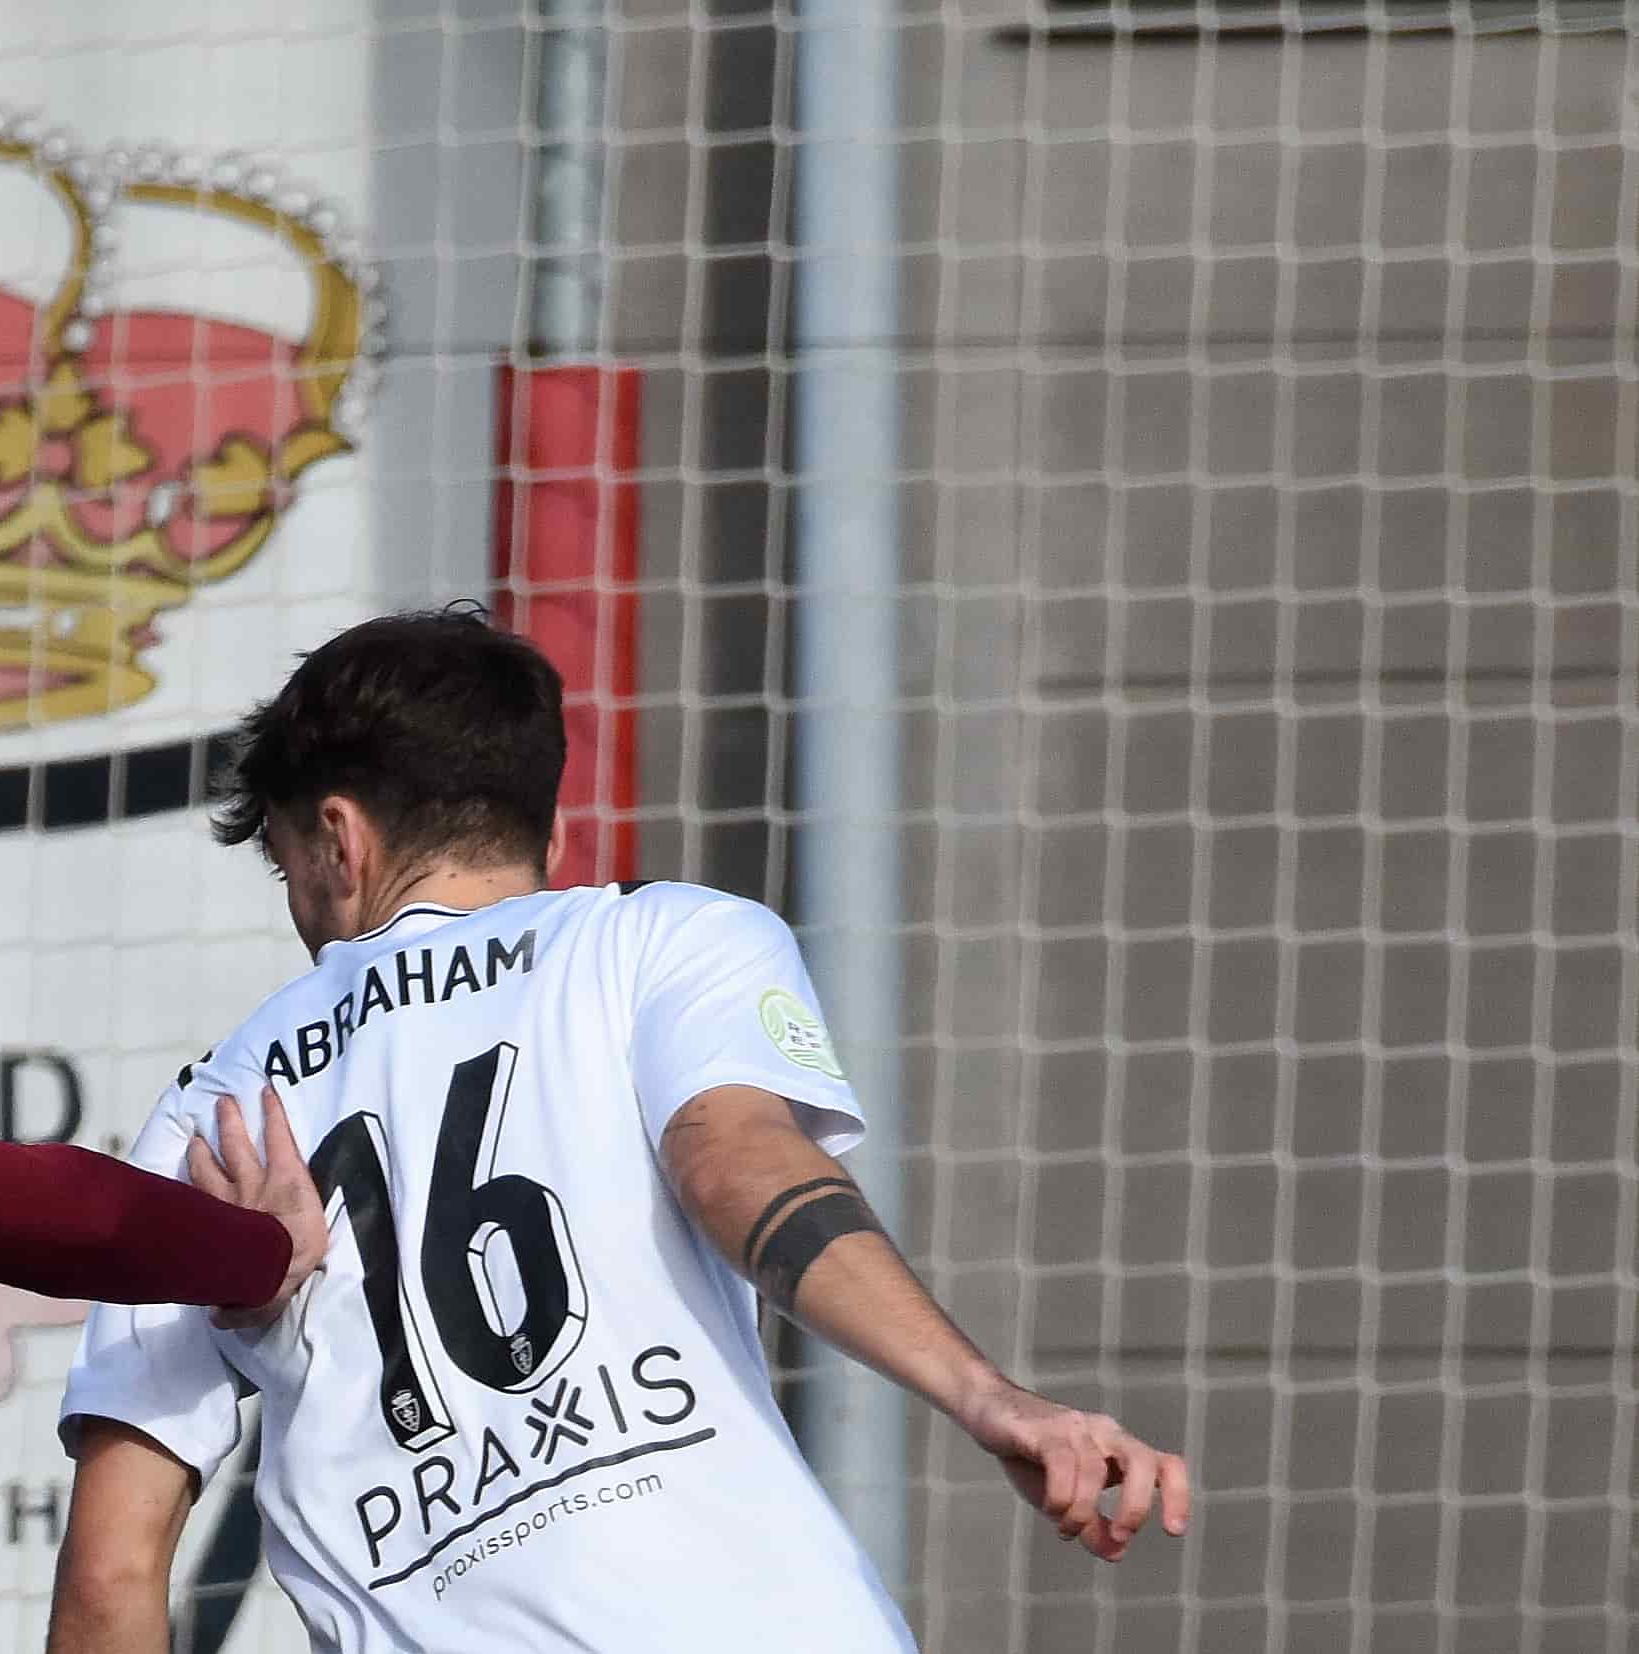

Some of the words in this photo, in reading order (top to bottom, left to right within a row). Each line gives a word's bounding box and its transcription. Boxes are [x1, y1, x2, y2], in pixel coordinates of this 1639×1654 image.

[264, 929, 538, 1087] ABRAHAM
[306, 1040, 590, 1454] 16
[354, 1344, 696, 1569] PRAXIS
